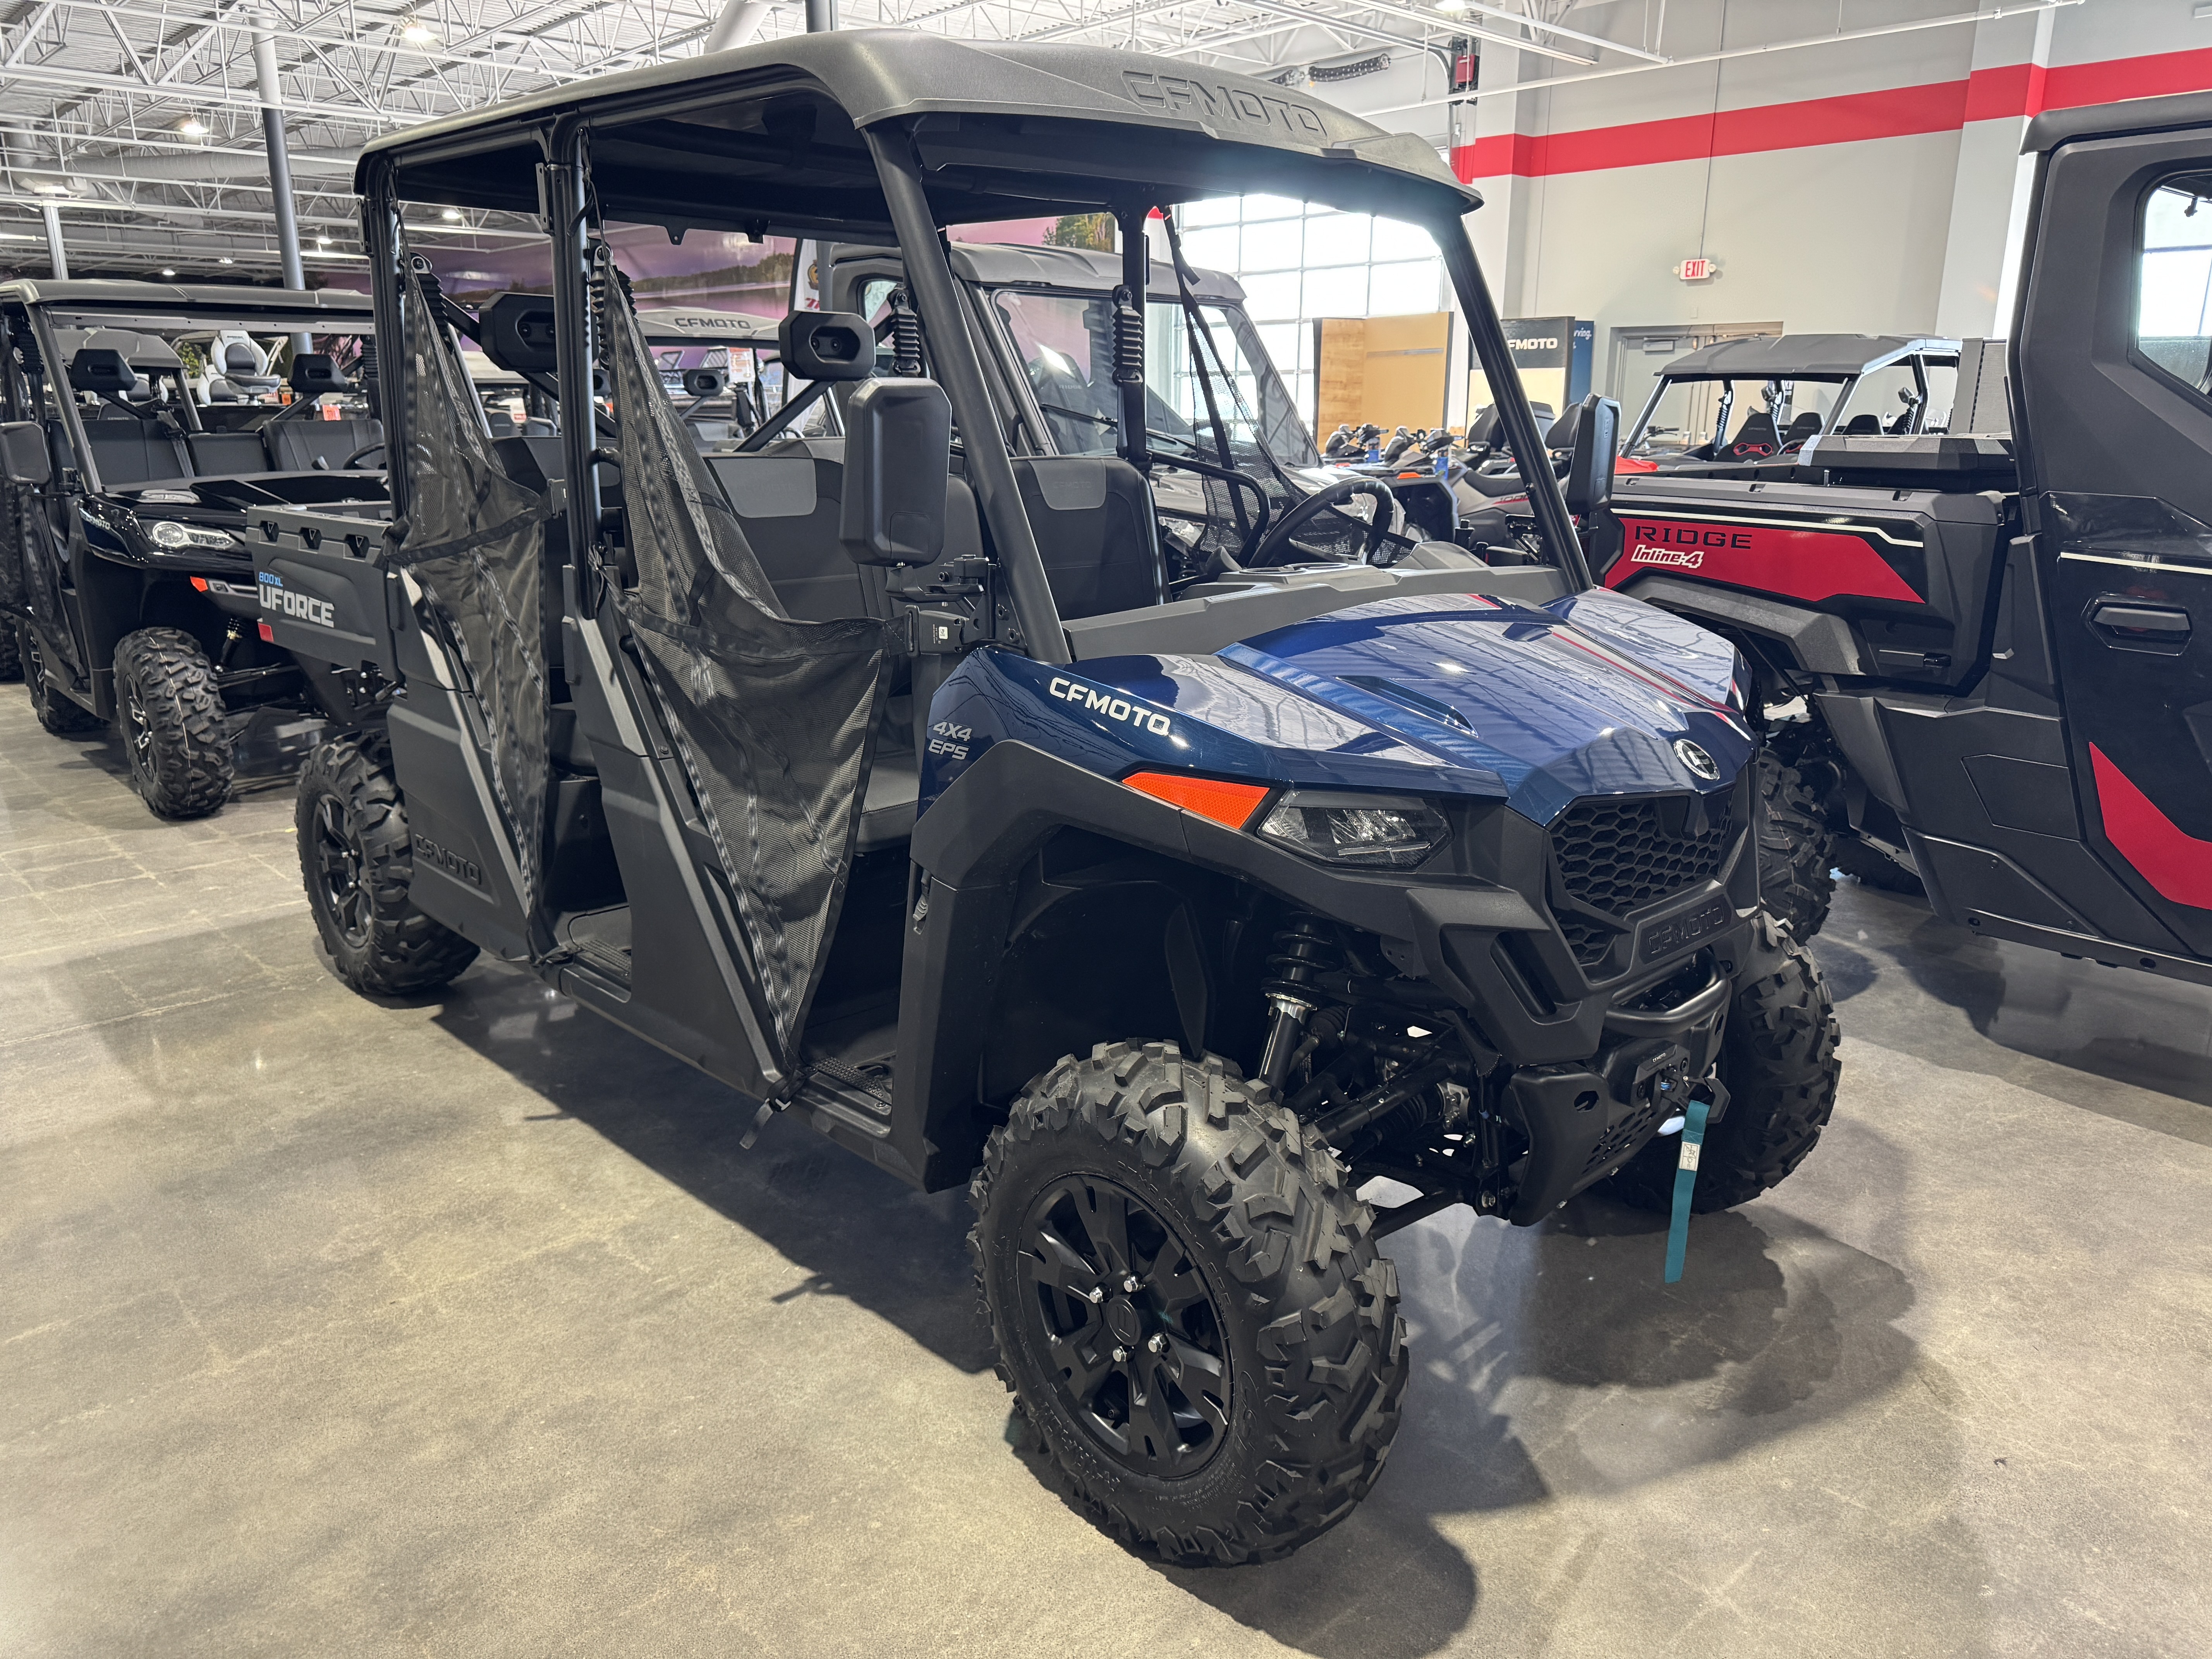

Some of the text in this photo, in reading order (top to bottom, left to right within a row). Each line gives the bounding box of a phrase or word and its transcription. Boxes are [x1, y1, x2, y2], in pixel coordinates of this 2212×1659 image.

[1121, 70, 1328, 139] CFMOTO
[1685, 260, 1706, 277] EXIT
[674, 317, 751, 329] CFMOTO
[1506, 337, 1558, 350] FMOTO
[1635, 526, 1752, 549] RIDGE
[1631, 544, 1705, 569] Inline-4
[258, 571, 283, 587] 800XL
[259, 584, 335, 628] UFORCE
[1049, 677, 1171, 736] CFMOTO
[932, 721, 972, 742] 4X4
[928, 739, 970, 760] EPS
[414, 833, 483, 885] CFMOTO
[1647, 905, 1725, 955] CFMOTO
